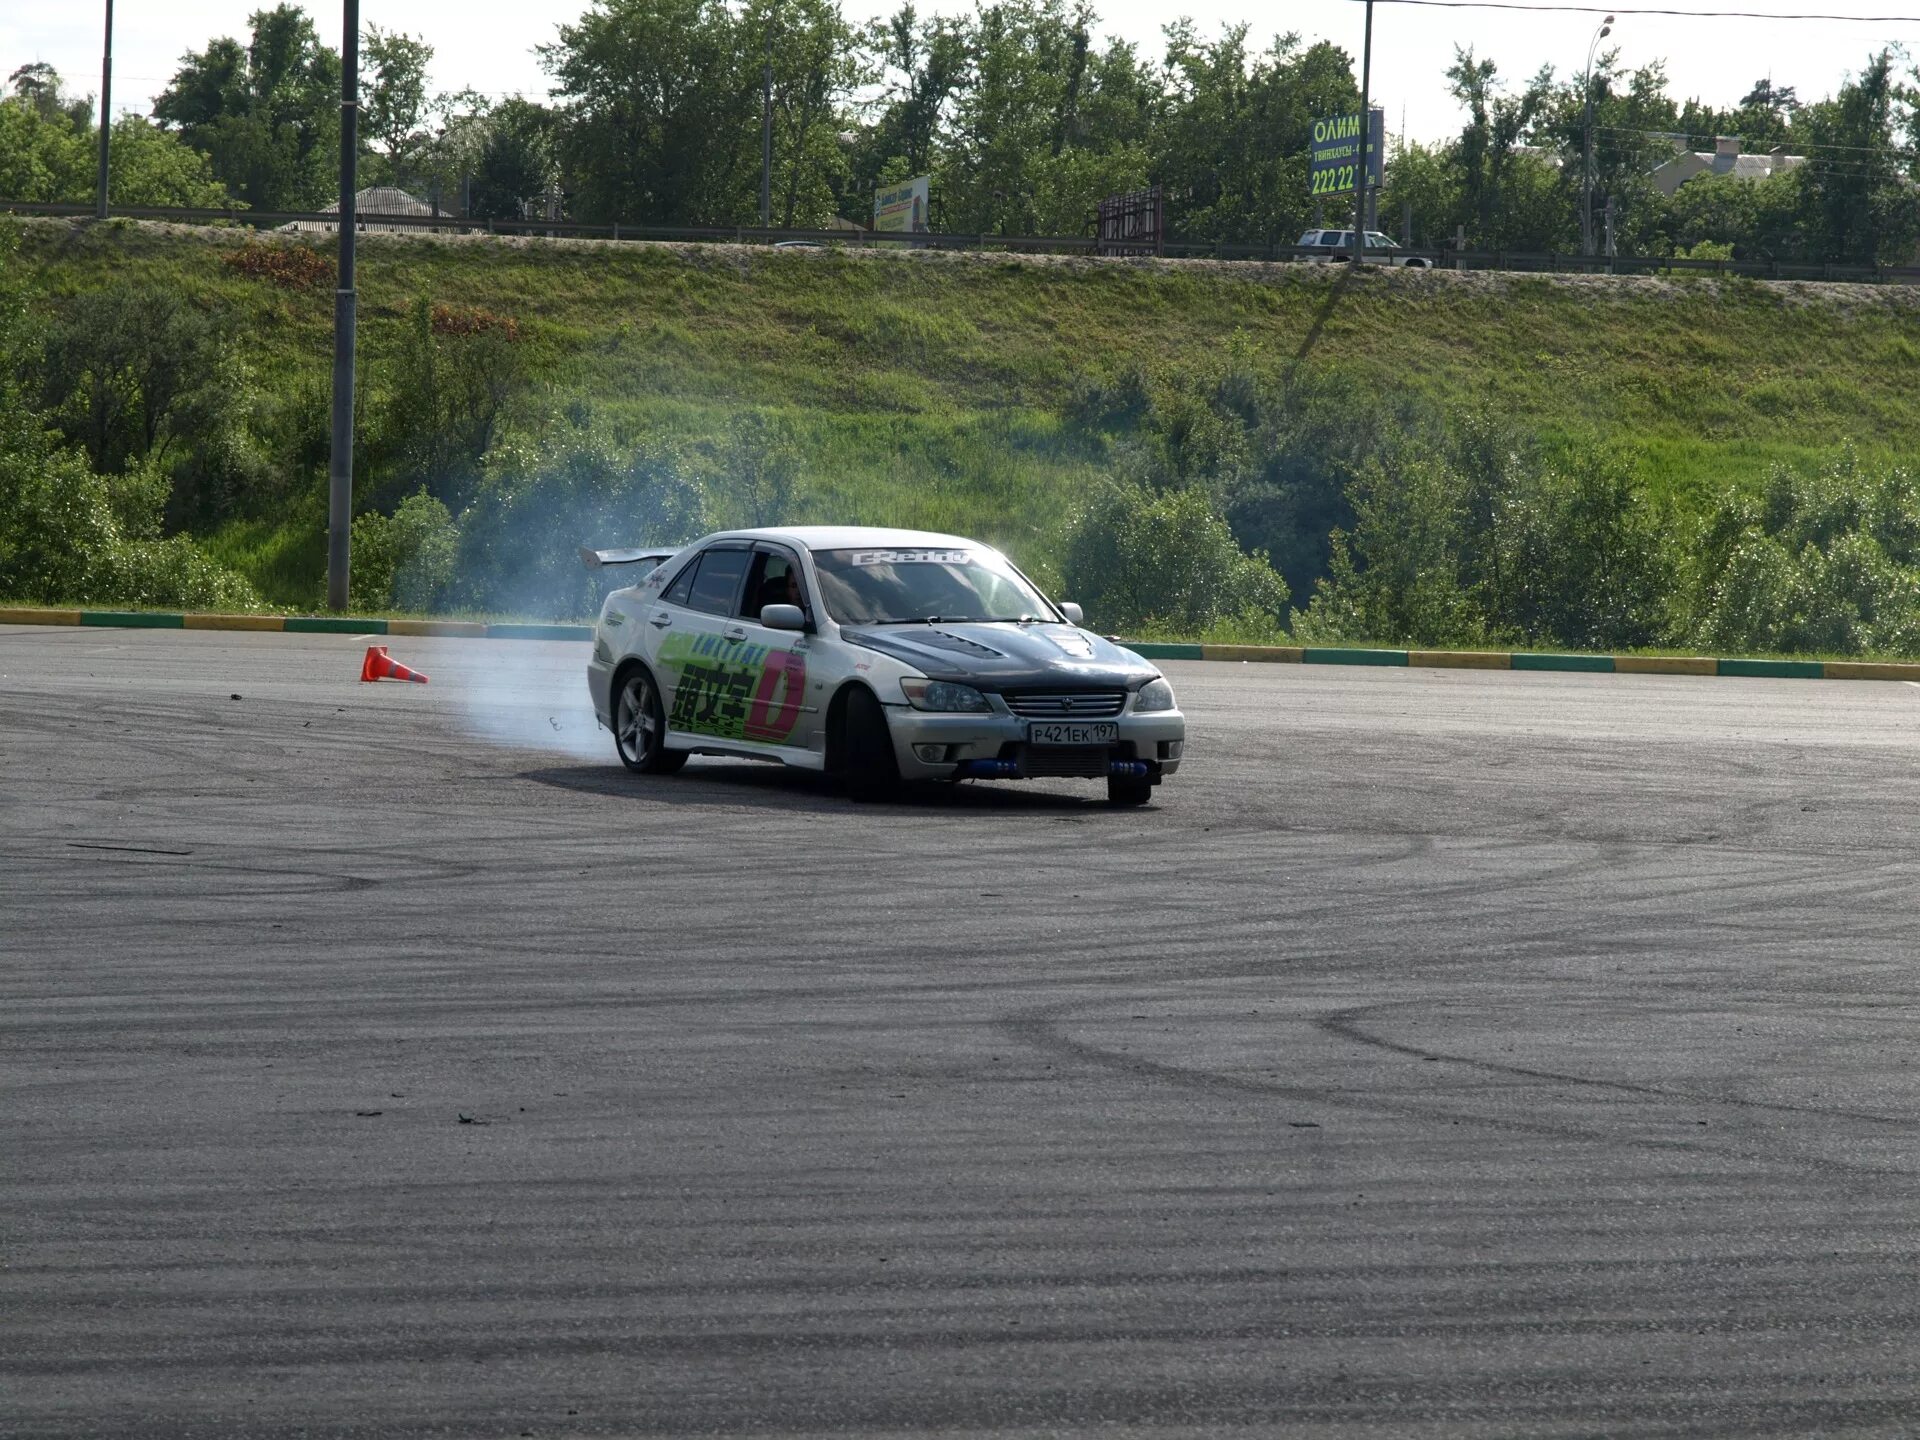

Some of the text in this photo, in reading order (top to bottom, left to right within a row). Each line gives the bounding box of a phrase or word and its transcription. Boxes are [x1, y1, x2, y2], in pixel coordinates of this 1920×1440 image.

[1312, 168, 1336, 195] 222
[743, 649, 806, 741] D
[1034, 726, 1089, 742] Р421ЕК
[1093, 724, 1114, 737] 197
